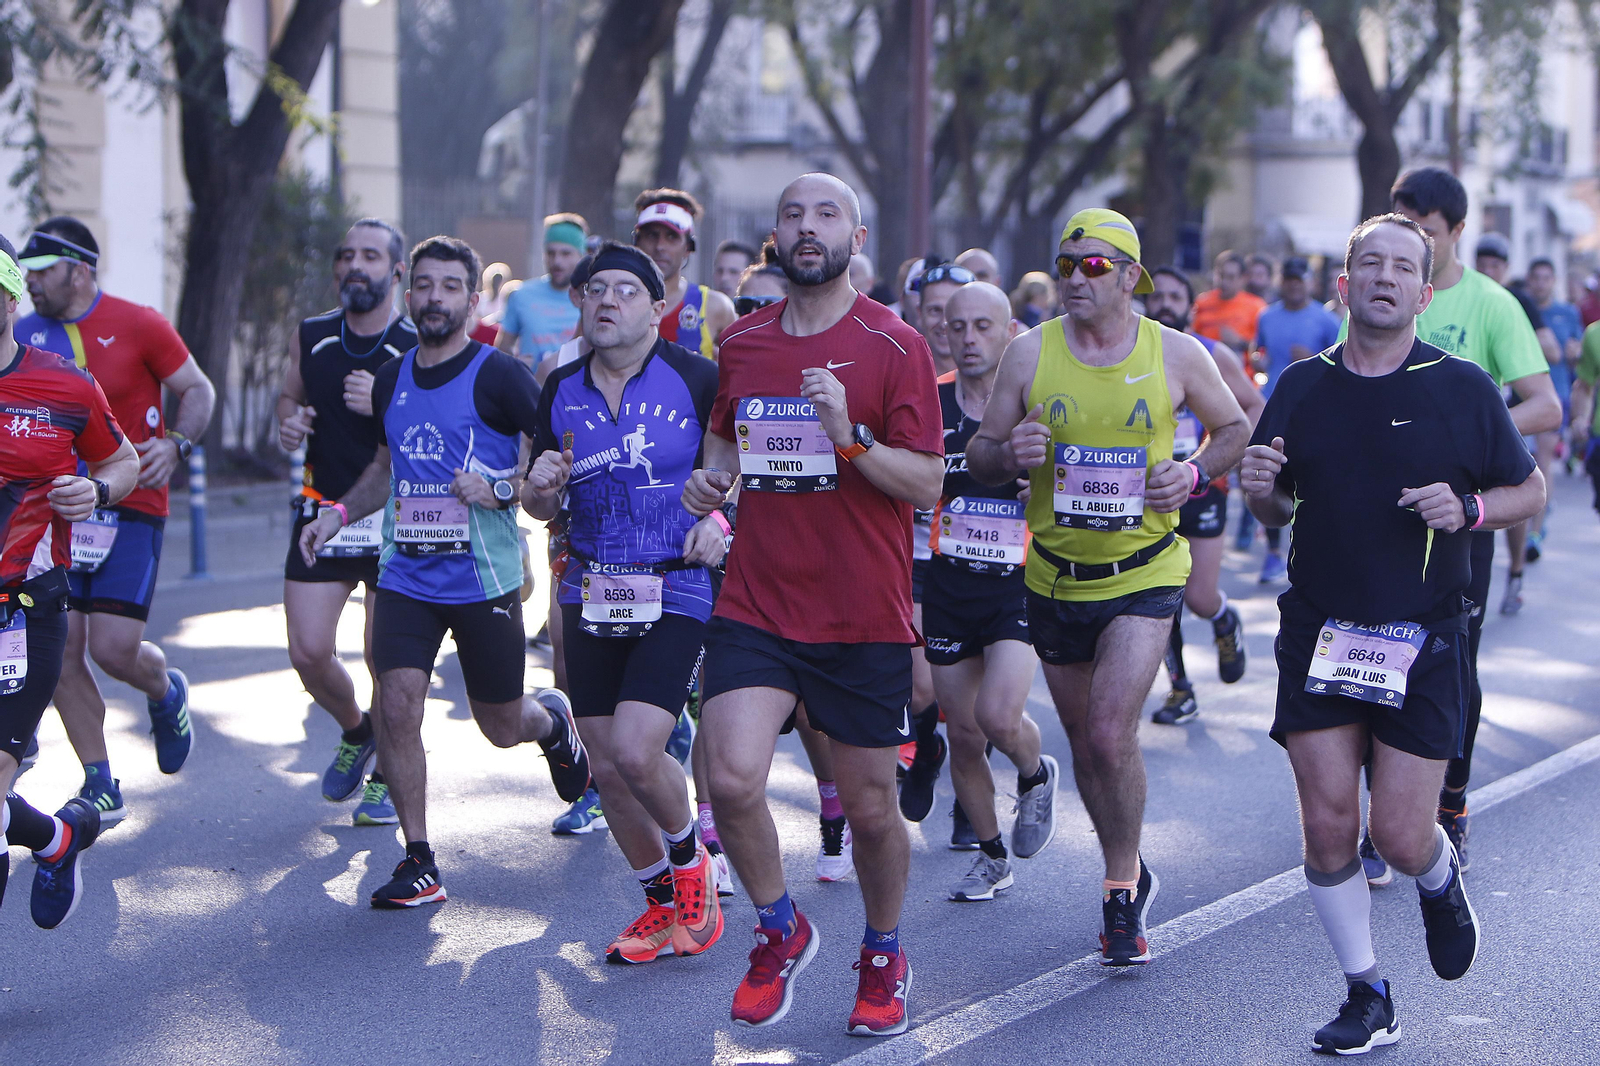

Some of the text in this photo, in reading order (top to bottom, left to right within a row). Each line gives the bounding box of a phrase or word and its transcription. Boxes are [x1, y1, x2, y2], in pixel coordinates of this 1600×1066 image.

[4, 407, 37, 415] ATLETISMO
[766, 436, 803, 451] 6337
[1083, 451, 1137, 464] ZURICH
[767, 459, 803, 472] TXINTO
[1082, 480, 1120, 495] 6836
[968, 501, 1018, 515] ZURICH
[1071, 499, 1125, 513] EL ABUELO
[412, 510, 443, 522] 8167
[344, 518, 373, 529] 282
[72, 532, 95, 545] 195
[340, 534, 371, 542] MIGUEL
[966, 527, 999, 542] 7418
[79, 550, 104, 560] TRIANA
[955, 544, 1006, 559] P. VALLEJO
[604, 588, 636, 601] 8593
[609, 608, 634, 619] ARCE
[1431, 643, 1450, 653] adidas
[1347, 648, 1386, 665] 6649
[0, 664, 17, 676] ER
[1332, 666, 1387, 684] JUAN LUIS
[3, 685, 24, 695] ZURICH
[1377, 698, 1399, 708] ZURICH
